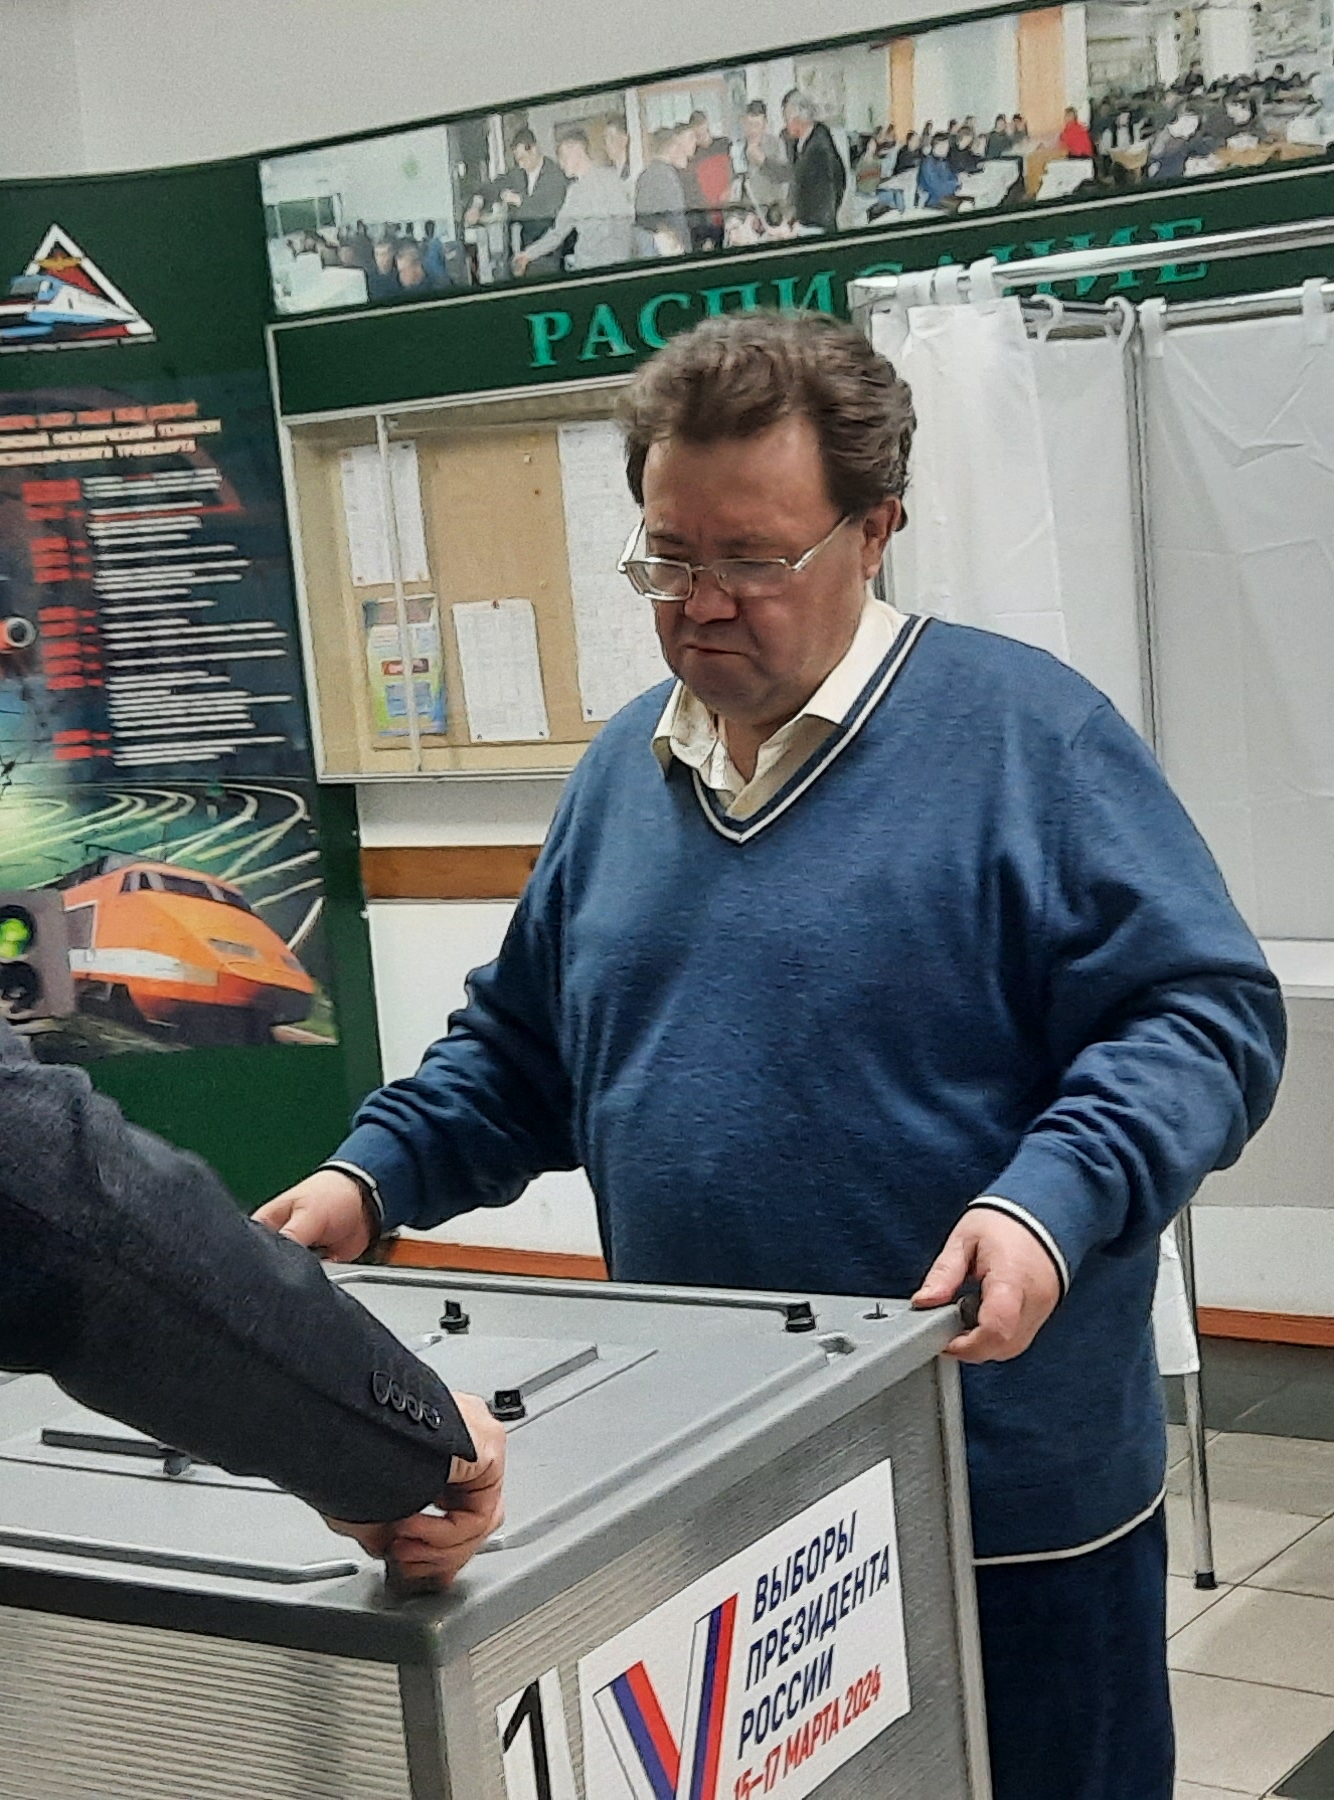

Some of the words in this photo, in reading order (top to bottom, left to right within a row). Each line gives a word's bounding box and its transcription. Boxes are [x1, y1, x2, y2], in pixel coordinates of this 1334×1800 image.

[524, 218, 1208, 368] РАСПИНИЕ
[744, 1544, 891, 1692] ПРЕЗИДЕНТА
[752, 1509, 858, 1624] ВЫБОРЫ
[502, 1680, 552, 1800] 1
[737, 1643, 835, 1761] РОССИИ
[782, 1696, 841, 1779] МАРТА
[842, 1663, 881, 1729] 2024
